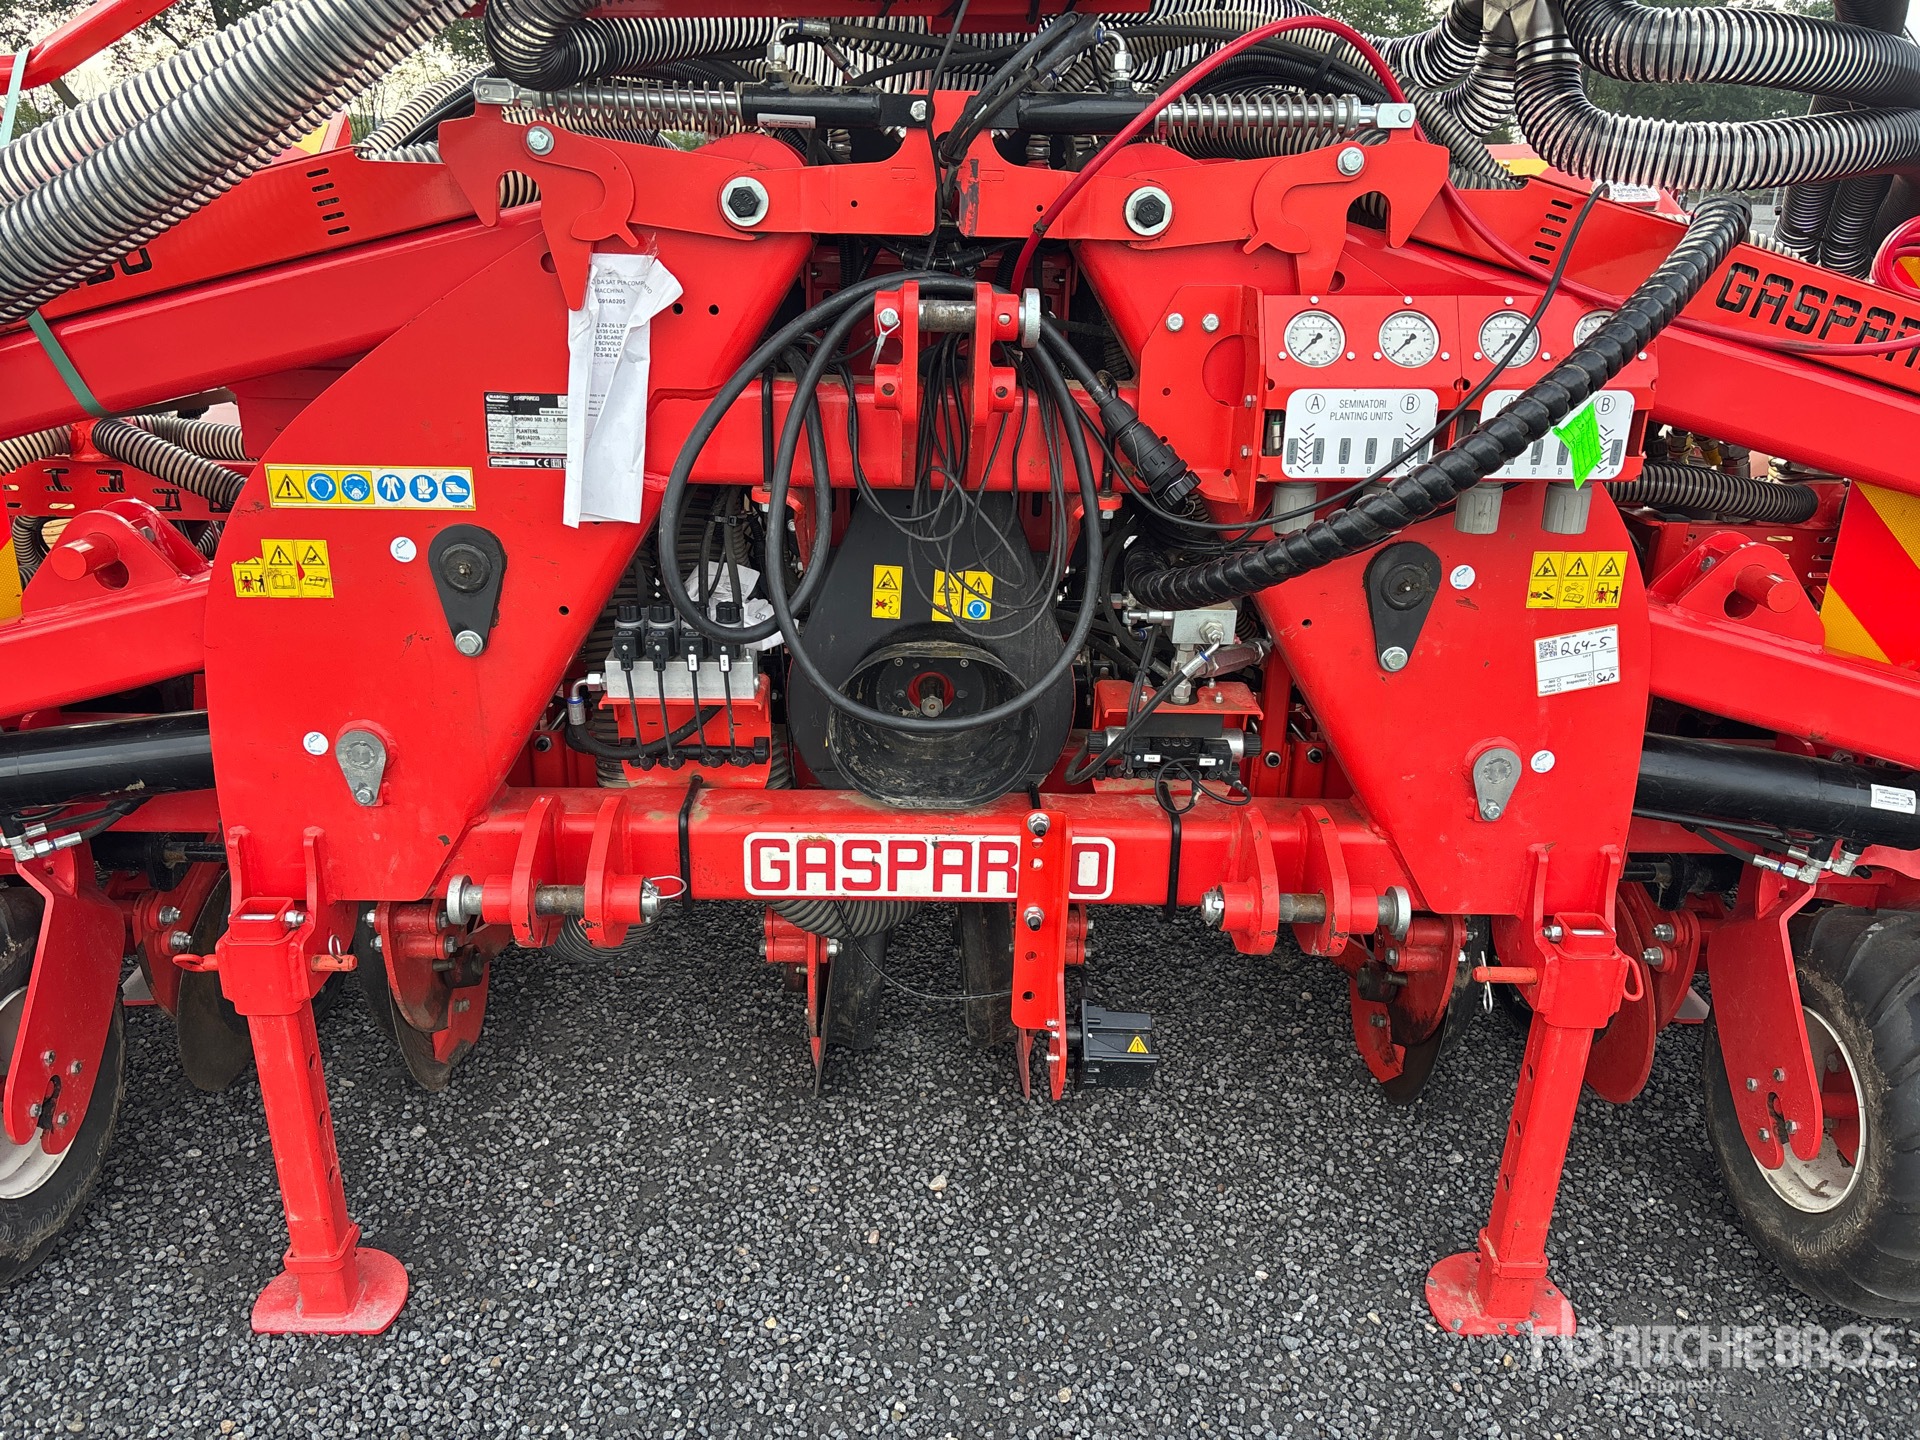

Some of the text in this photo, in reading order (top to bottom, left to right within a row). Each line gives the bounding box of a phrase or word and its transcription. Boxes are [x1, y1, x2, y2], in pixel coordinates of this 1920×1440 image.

[1310, 395, 1415, 411] A SEMINATORI B
[1601, 397, 1611, 412] B
[1330, 411, 1393, 421] PLANTING UNITS
[1288, 466, 1293, 474] A
[1314, 466, 1319, 474] A
[1340, 466, 1345, 474] B
[1366, 466, 1371, 474] B
[1505, 467, 1511, 475] A
[1531, 467, 1537, 475] B
[1557, 467, 1563, 475] B
[1609, 467, 1615, 475] A
[750, 838, 1110, 895] GASPARO
